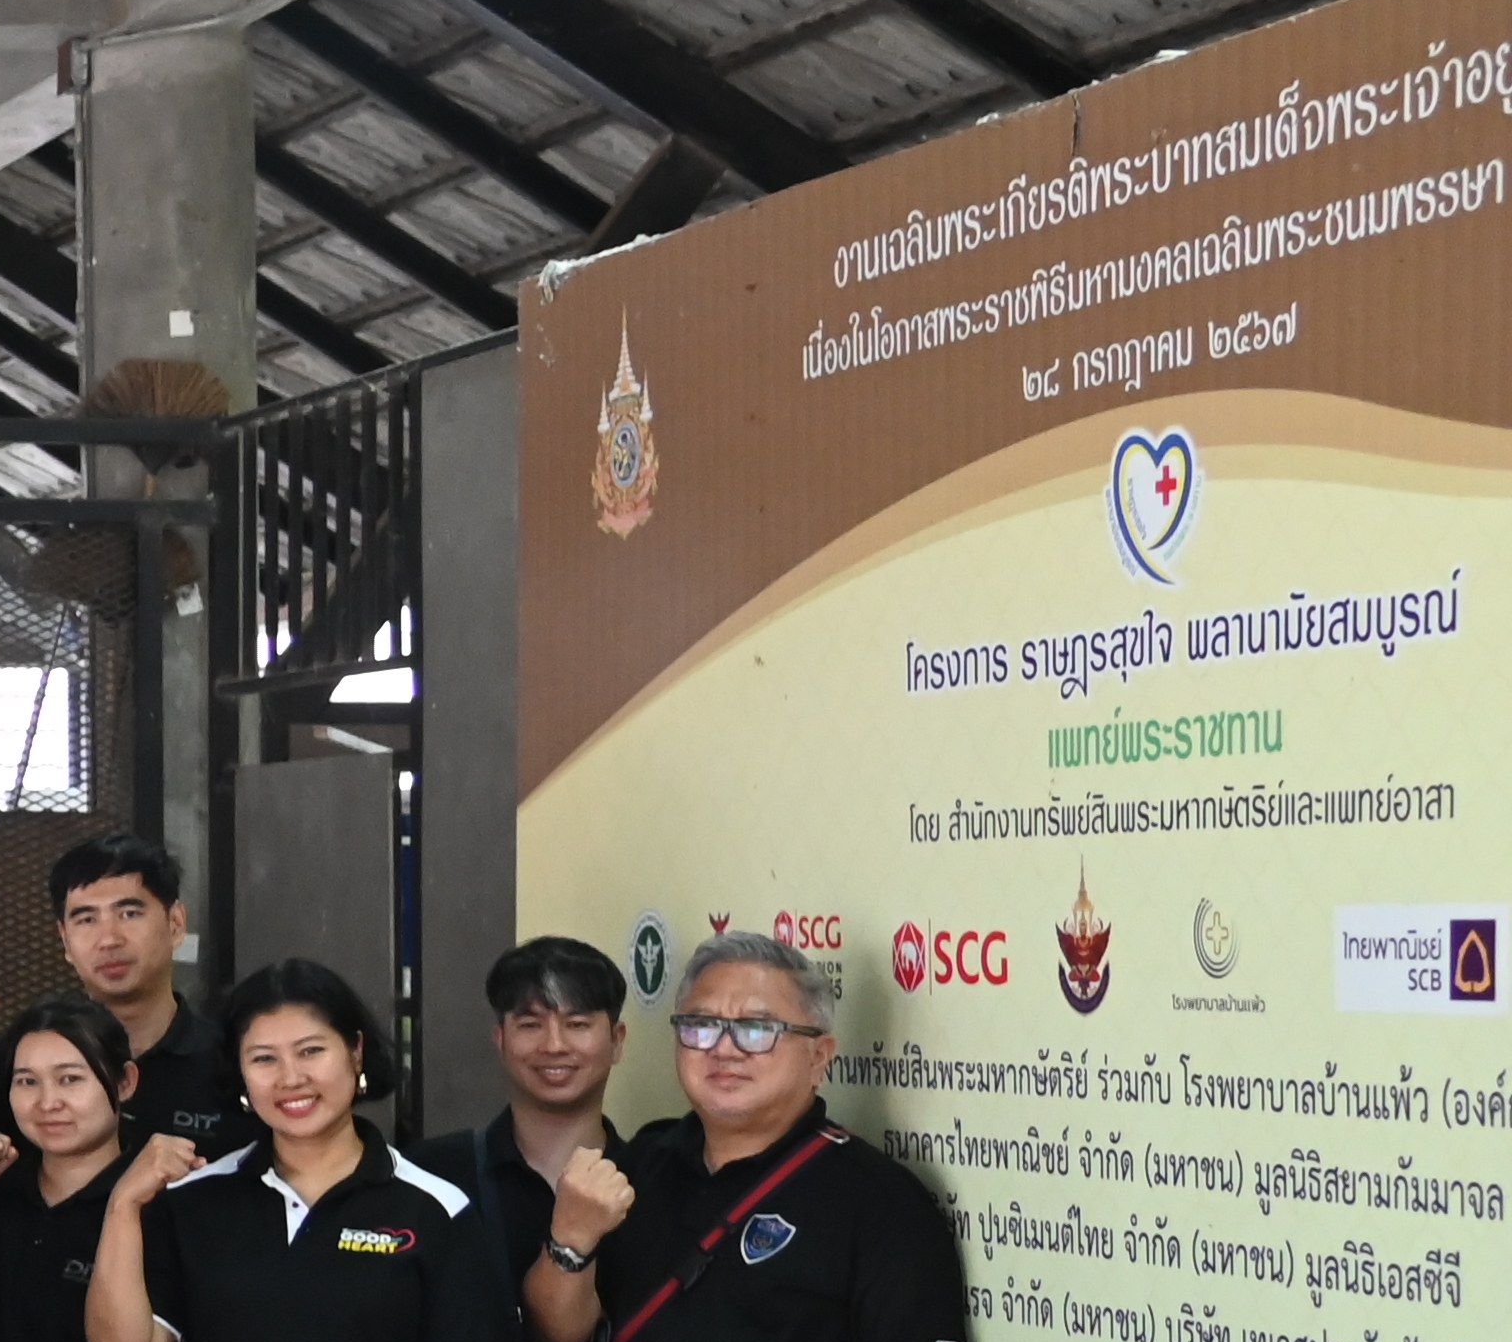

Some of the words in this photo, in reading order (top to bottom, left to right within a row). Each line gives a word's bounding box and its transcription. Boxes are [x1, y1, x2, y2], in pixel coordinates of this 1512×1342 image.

[801, 158, 1504, 381] เนื่องในโอกาสพระราชพิธีมหามงคลเฉลิมพระชนมพรรษา
[1022, 362, 1060, 401] ๒๘
[1072, 325, 1193, 393] กรกฎาคม
[1208, 302, 1298, 361] ๒๕๖๗
[906, 641, 1009, 692] โครงการ
[1187, 567, 1461, 658] พลานามัยสมบูรณ์
[1047, 705, 1284, 768] แพทย์พระราชทาน
[910, 804, 941, 843] โดย
[949, 774, 1457, 842] สำนักงานทรัพย์สินพระมหากษัตริย์และแพทย์อาสา
[798, 915, 842, 950] SCG
[933, 930, 1009, 987] SCG
[1342, 929, 1443, 964] ไทยพาณิชย์
[1407, 967, 1443, 993] SCB
[1097, 1053, 1171, 1105] ร่วมกับ
[1181, 1058, 1429, 1124] โรงพยาบาลบ้านแพ้ว
[1443, 1068, 1512, 1130] (องค์
[884, 1121, 1068, 1173] ธนาคารไทยพาณิชย์
[1078, 1133, 1133, 1182] จำกัด
[1143, 1142, 1243, 1196] (มหาชน)
[1252, 1148, 1505, 1222] มูลนิธิสยามกัมมาจล
[337, 1241, 399, 1255] HEART
[340, 1231, 393, 1245] GOOD
[977, 1206, 1114, 1263] ปูนซิเมนต์ไทย
[1123, 1215, 1181, 1269] จำกัด
[1191, 1227, 1294, 1286] (มหาชน)
[1305, 1242, 1462, 1310] มูลนิธิเอสซีจี
[1001, 1275, 1054, 1329] จำกัด
